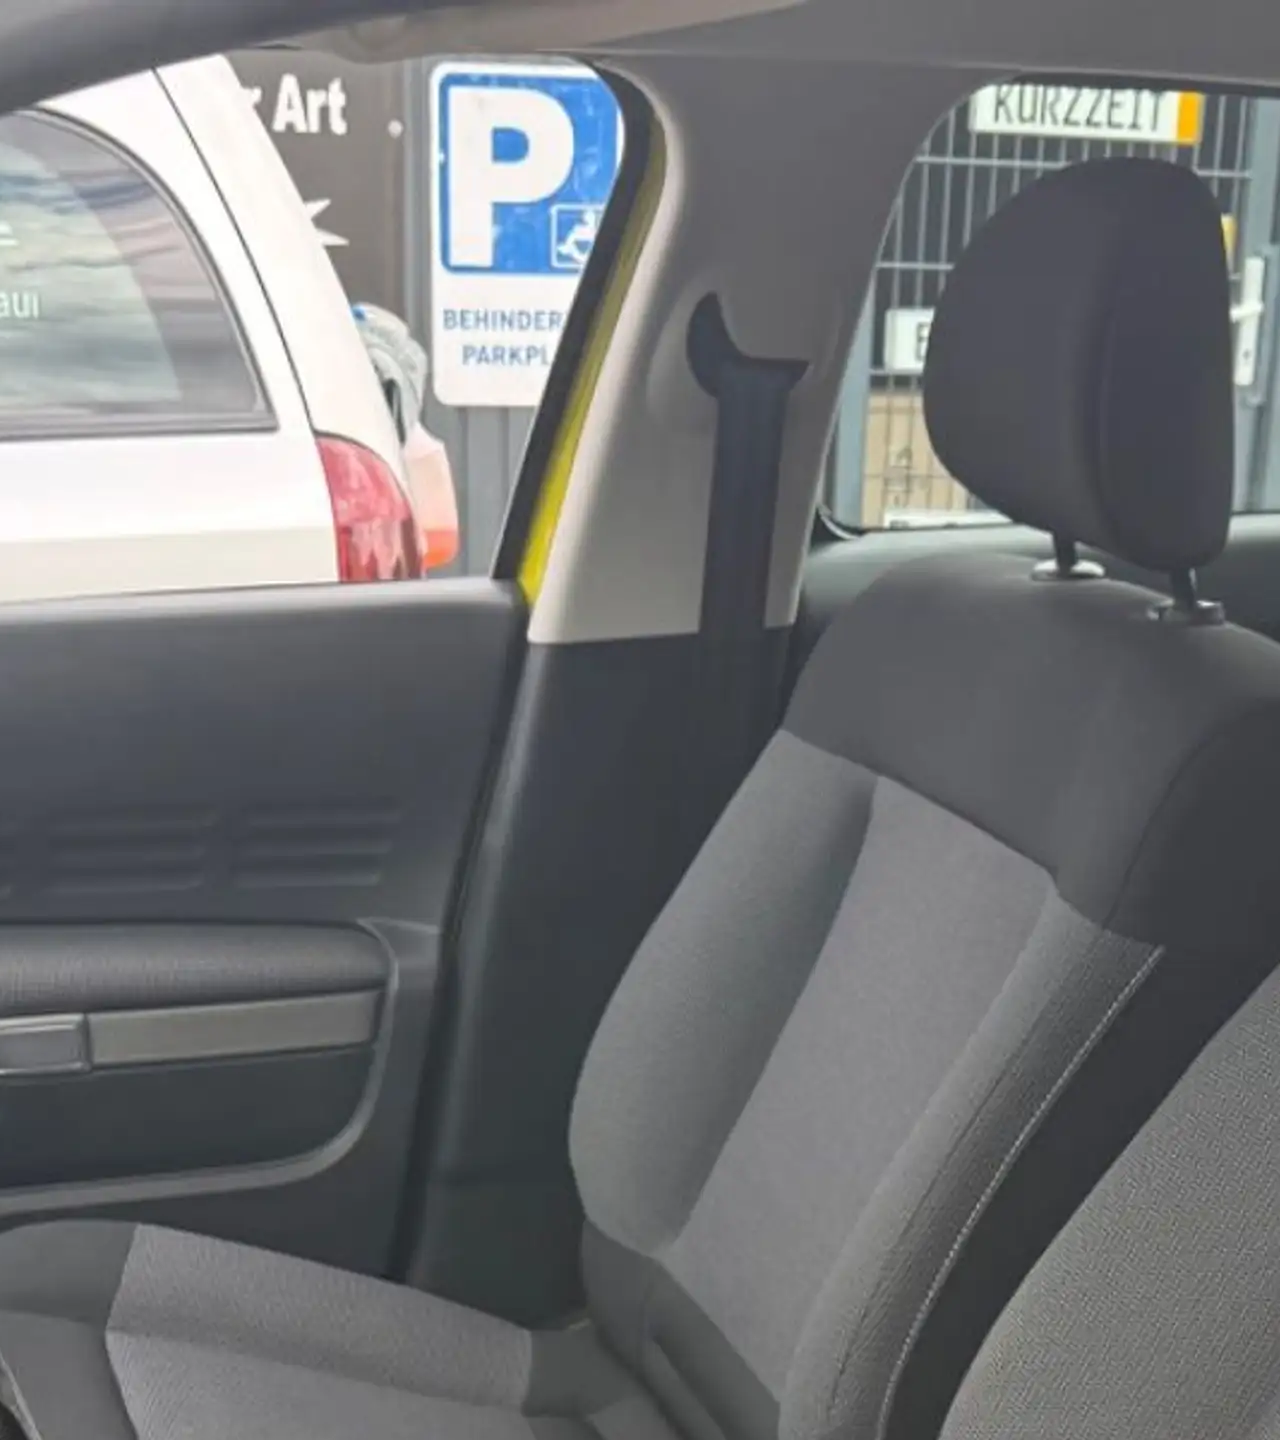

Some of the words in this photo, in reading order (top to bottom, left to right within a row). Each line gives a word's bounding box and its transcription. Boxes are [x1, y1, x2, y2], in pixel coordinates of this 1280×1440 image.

[271, 72, 348, 136] Art
[994, 84, 1162, 132] KURZZEIT
[447, 85, 575, 268] P
[442, 308, 562, 332] BEHINDER
